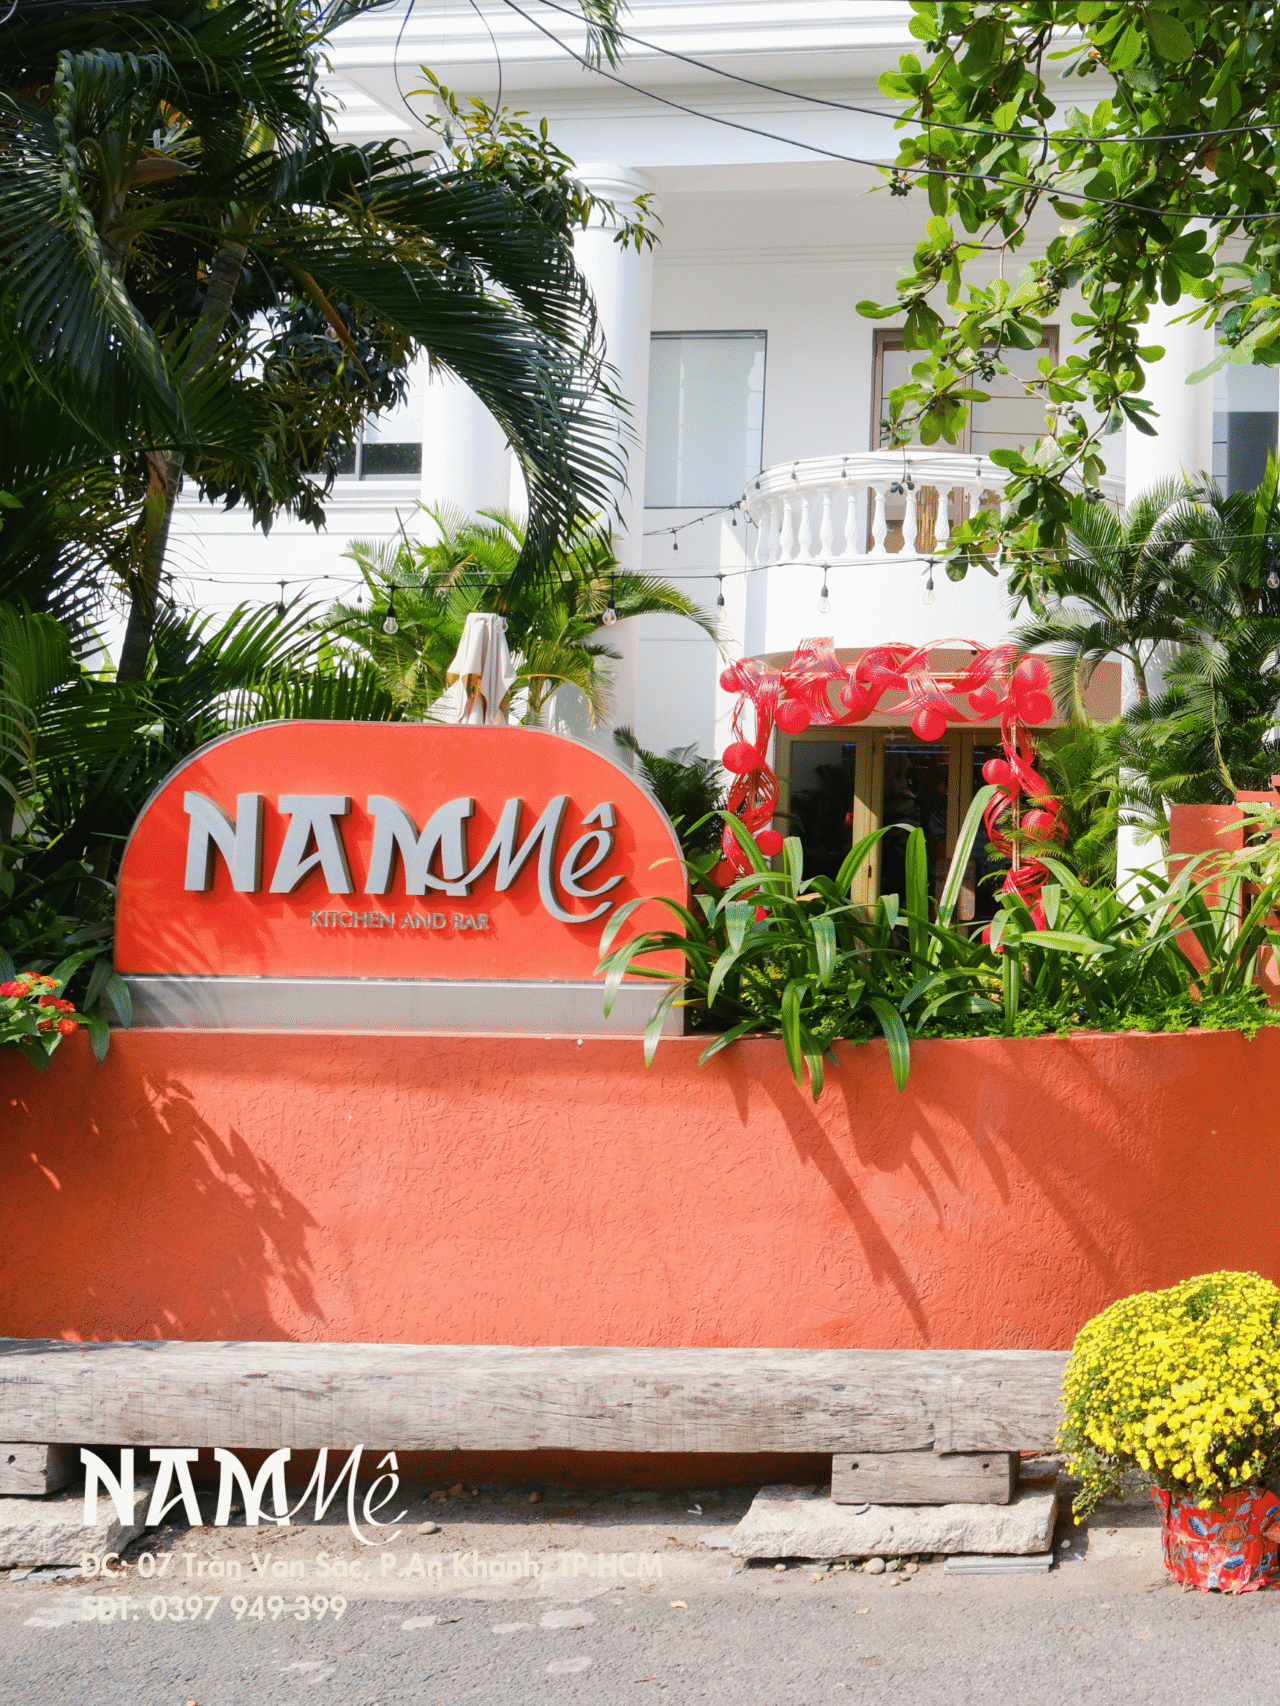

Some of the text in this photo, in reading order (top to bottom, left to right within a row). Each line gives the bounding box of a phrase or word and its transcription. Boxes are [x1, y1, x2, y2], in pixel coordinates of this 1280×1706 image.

[310, 911, 490, 930] KITCHEN AND BAR
